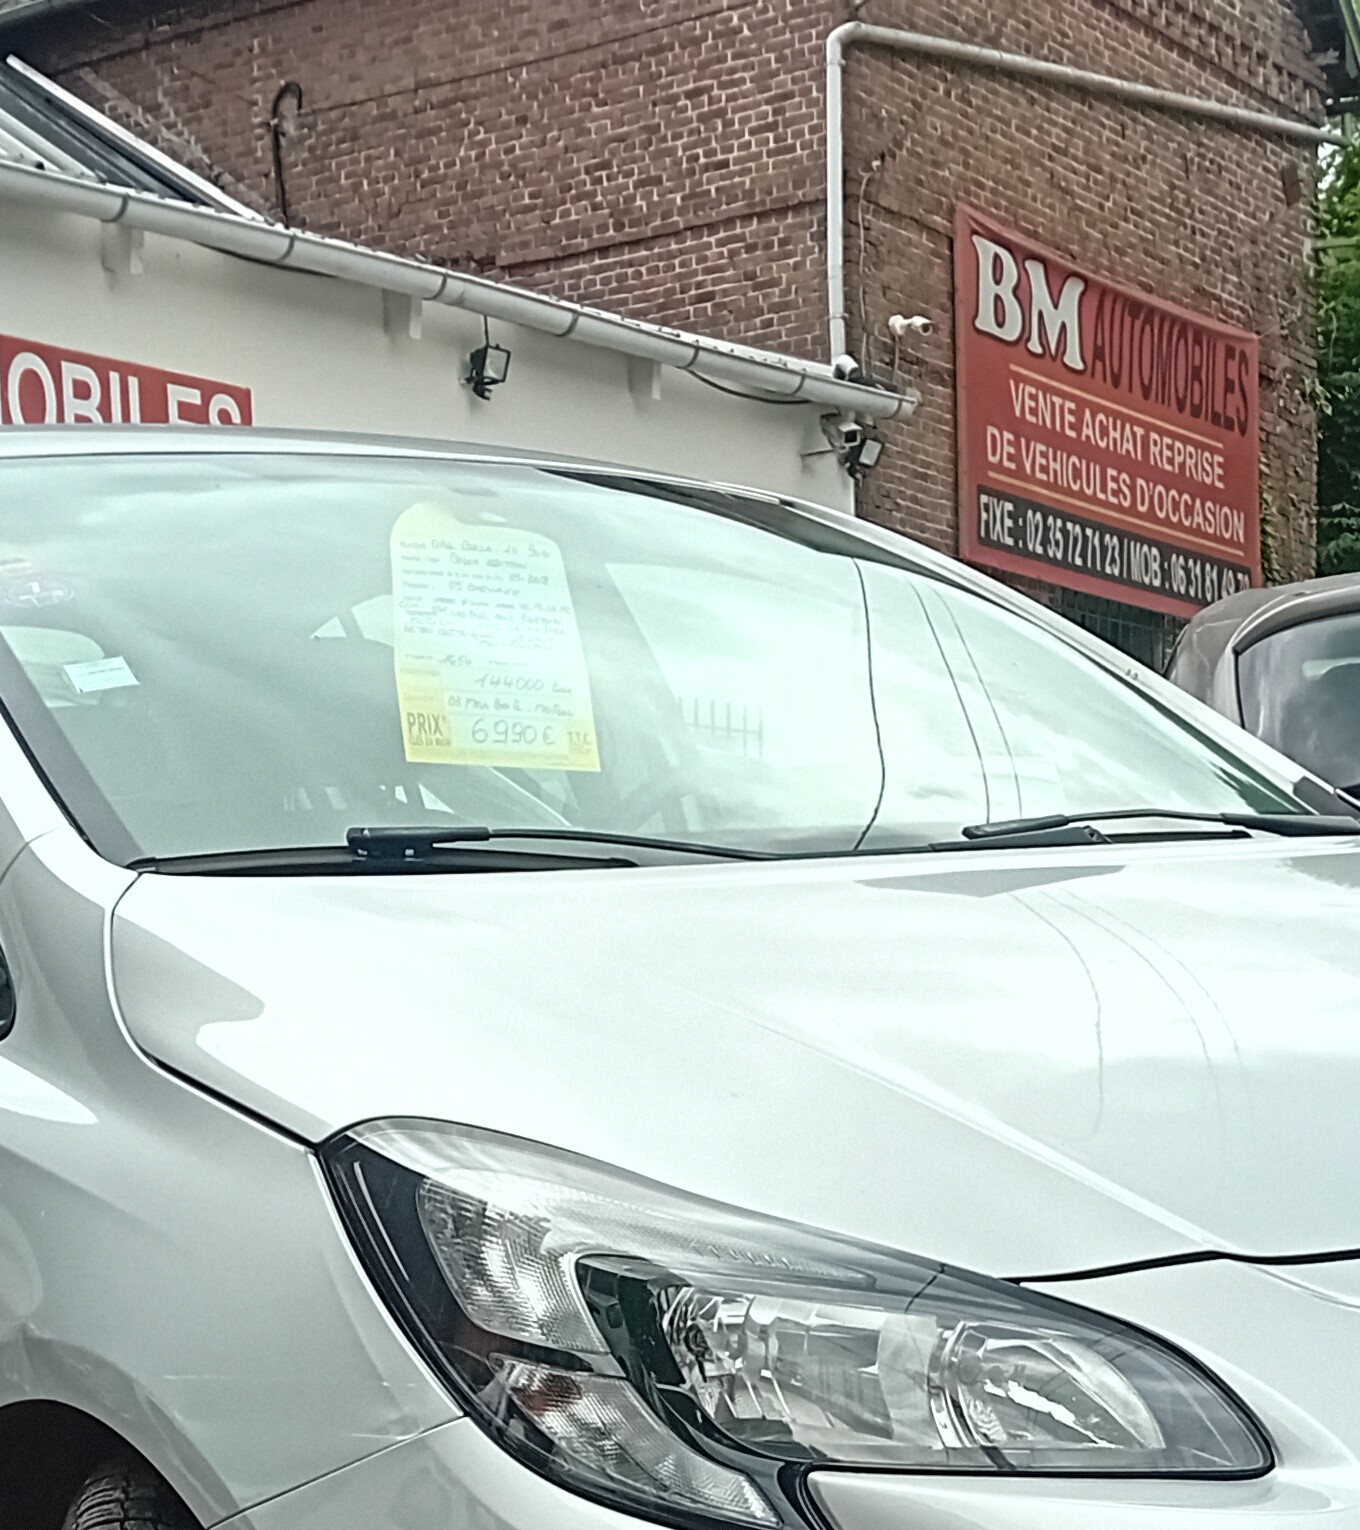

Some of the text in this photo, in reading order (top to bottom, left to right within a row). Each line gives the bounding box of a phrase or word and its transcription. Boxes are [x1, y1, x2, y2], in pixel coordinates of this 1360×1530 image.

[971, 234, 1250, 438] BM AUTOMOBILES
[986, 425, 1245, 544] DE VEHICULES D'OCCASION
[1009, 378, 1225, 489] VENTE ACHAT REPRISE
[980, 494, 1016, 546] FIXE
[1026, 508, 1044, 554] 02
[1046, 517, 1064, 563] 35
[1066, 523, 1084, 569] 72
[1085, 528, 1102, 575] 71
[1104, 531, 1120, 579] 23
[1130, 540, 1162, 588] MOB
[1170, 552, 1187, 595] 06
[1187, 558, 1202, 600] 31
[1204, 562, 1219, 603] 81
[471, 718, 537, 744] 6990
[474, 672, 545, 692] 144000
